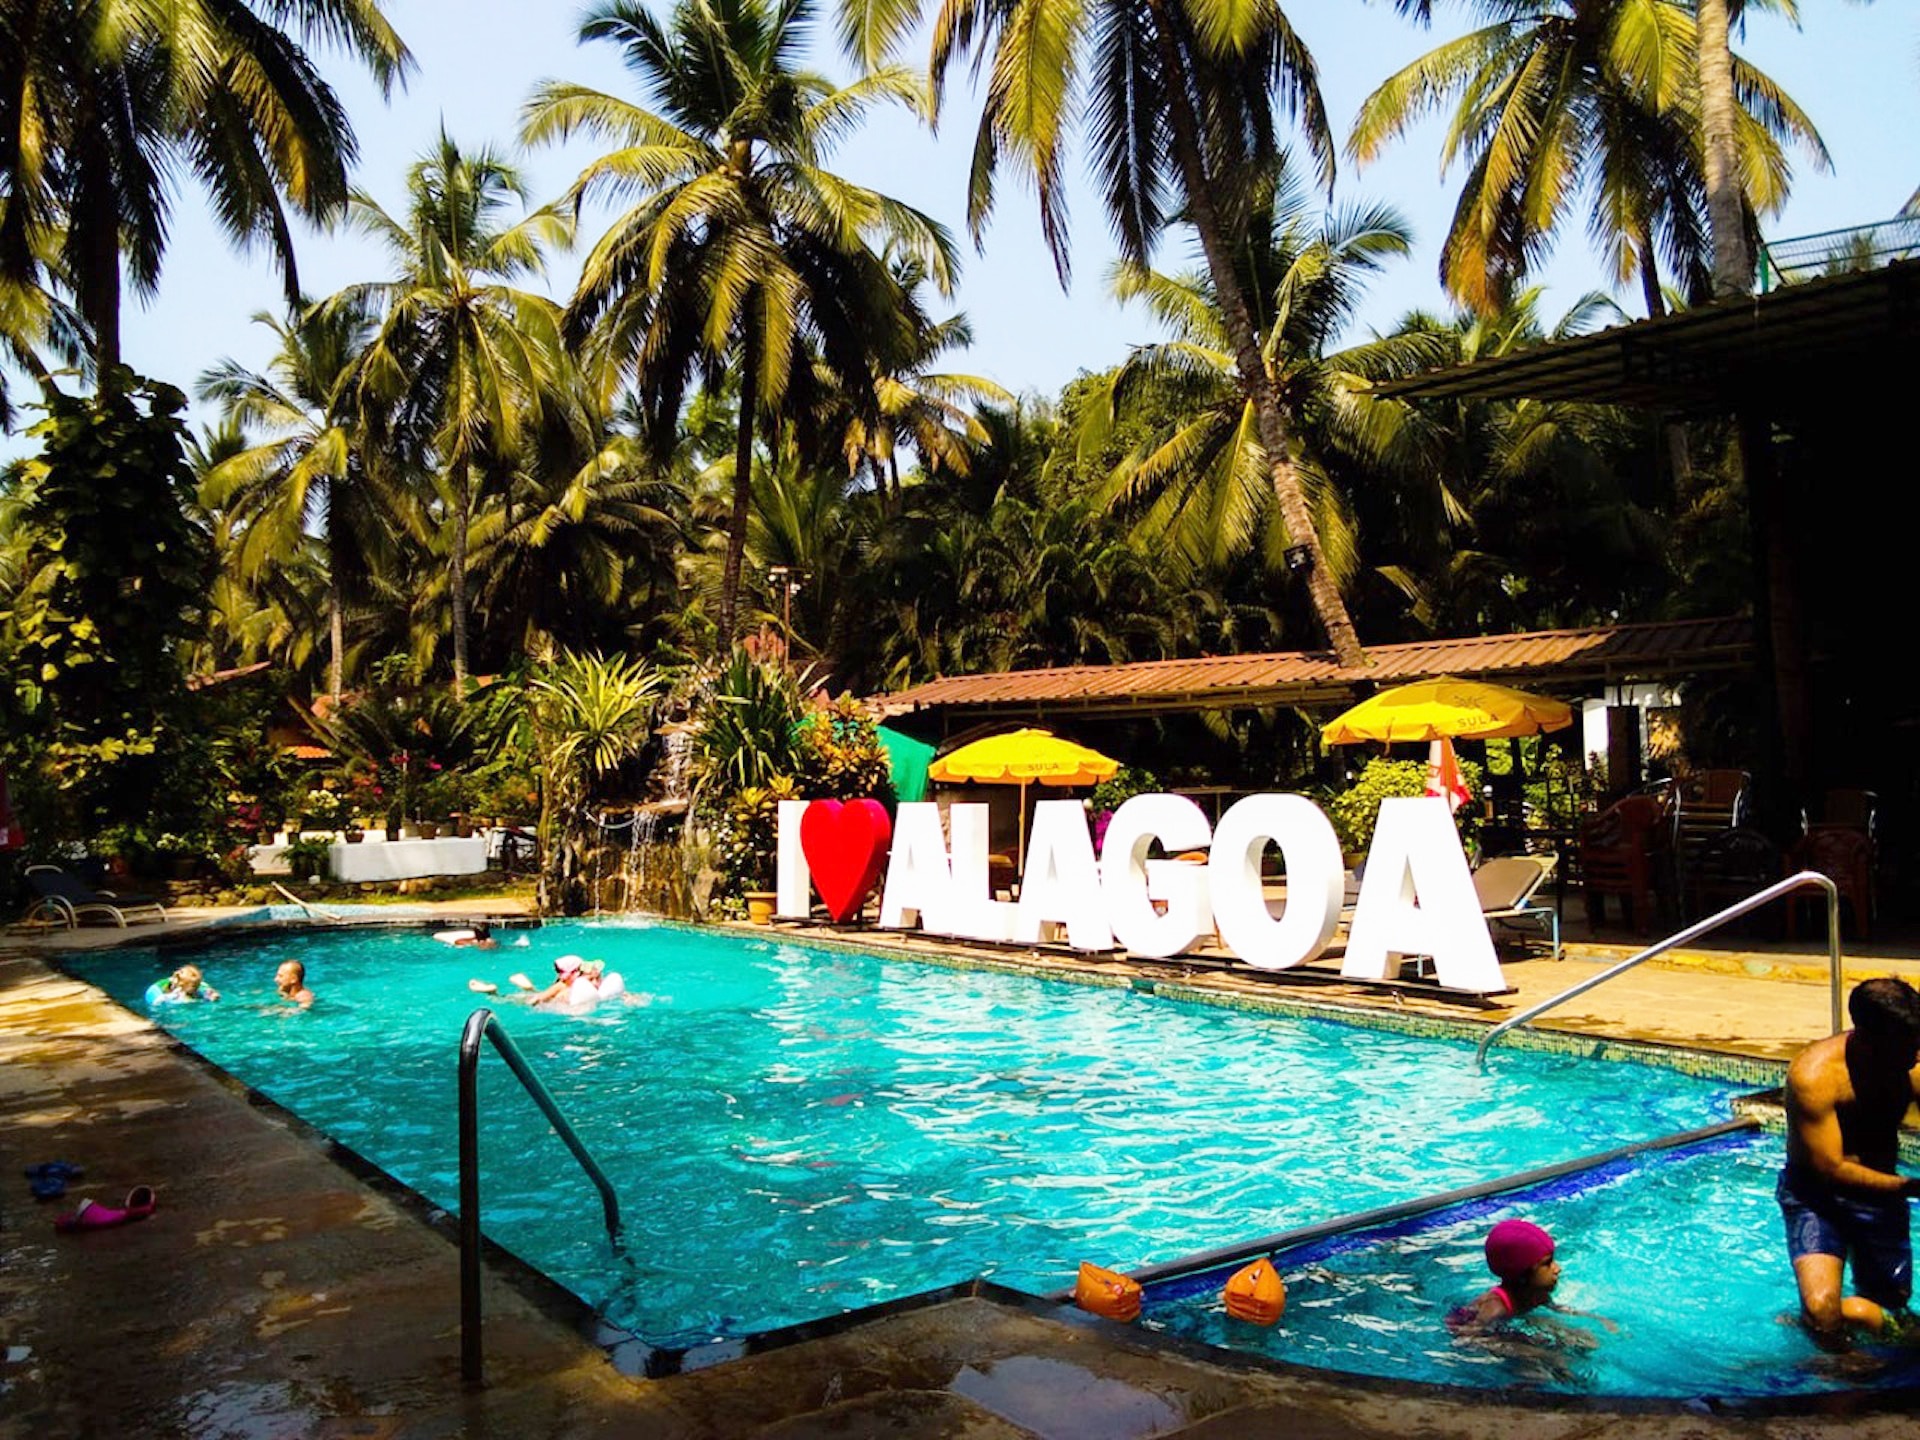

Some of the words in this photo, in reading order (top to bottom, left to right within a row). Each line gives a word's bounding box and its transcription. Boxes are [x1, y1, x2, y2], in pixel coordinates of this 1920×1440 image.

[1458, 714, 1499, 727] SULA
[1028, 763, 1059, 772] SULA
[777, 800, 810, 919] I
[879, 793, 1507, 993] ALAGOA
